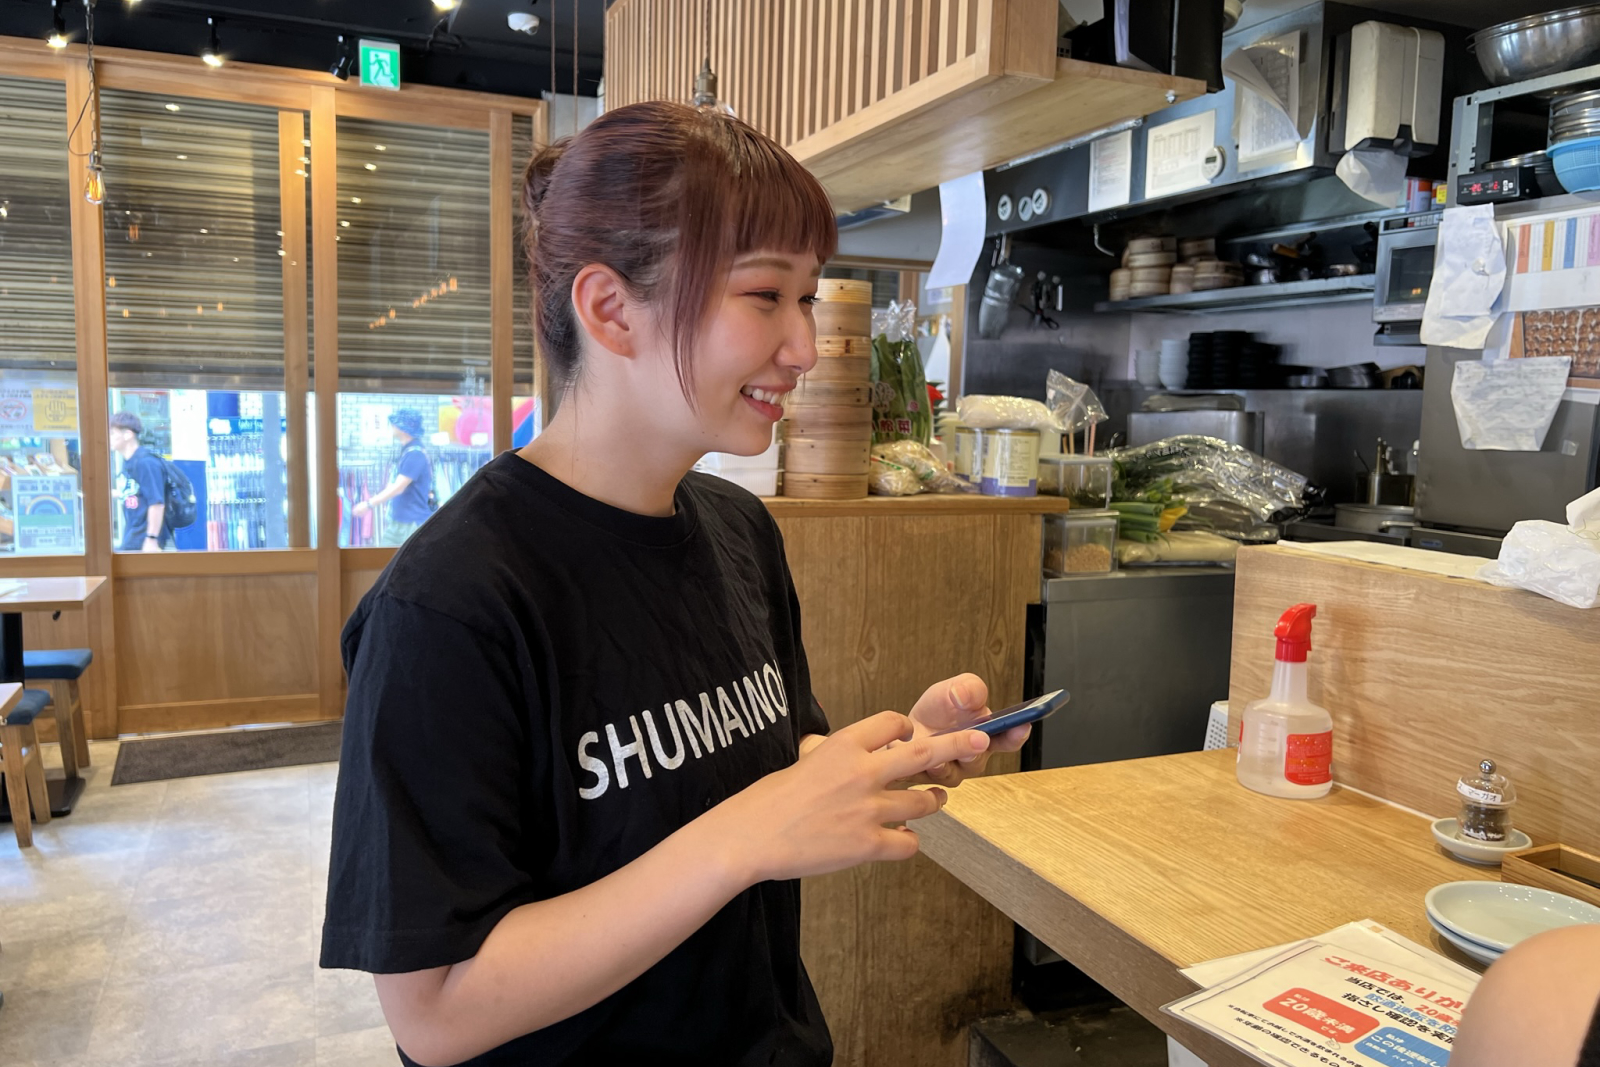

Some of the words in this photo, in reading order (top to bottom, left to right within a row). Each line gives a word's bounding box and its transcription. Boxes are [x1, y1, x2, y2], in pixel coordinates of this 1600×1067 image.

[577, 658, 790, 800] SHUMAINO
[1324, 955, 1466, 1014] ご来店ありが
[1278, 997, 1356, 1034] 20歳未満
[1370, 1034, 1446, 1067] この後運転し
